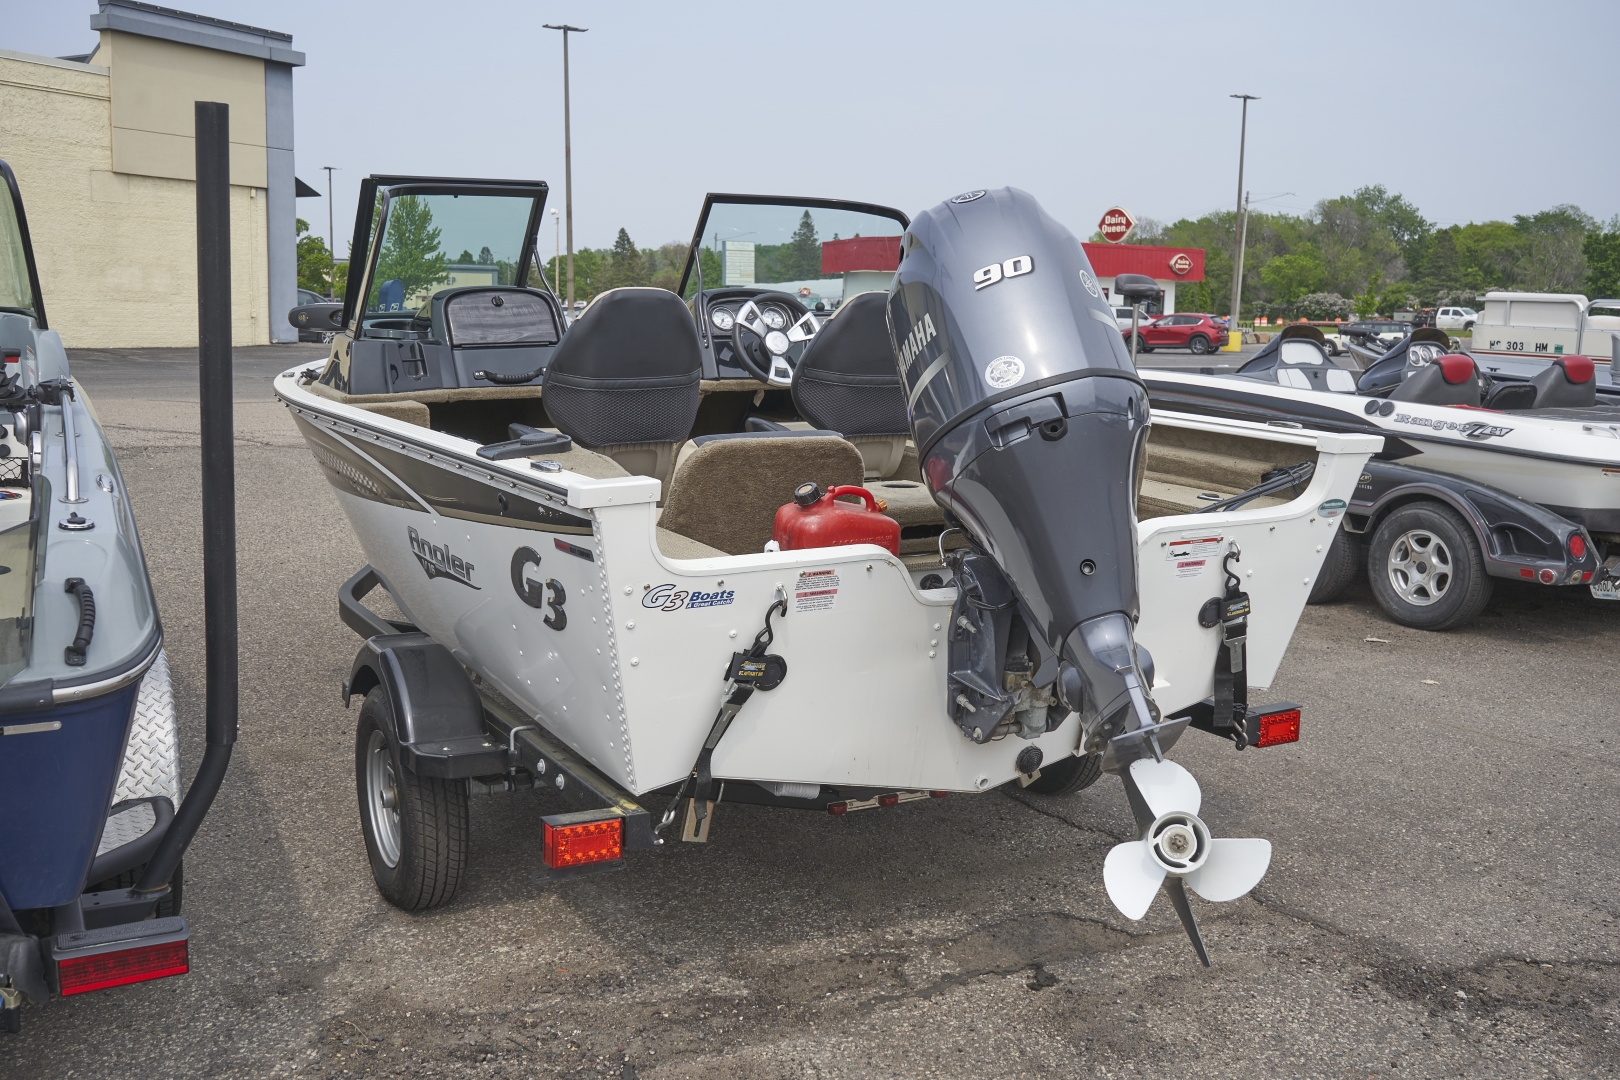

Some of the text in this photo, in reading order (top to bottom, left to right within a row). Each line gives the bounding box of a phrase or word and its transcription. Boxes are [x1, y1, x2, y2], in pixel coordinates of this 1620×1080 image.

[1104, 214, 1126, 225] Dairy
[973, 254, 1034, 291] 90
[1506, 341, 1525, 351] 303
[1534, 342, 1549, 353] HM
[1393, 412, 1469, 433] Ranger
[407, 525, 475, 582] Angler
[510, 545, 568, 632] G3
[641, 583, 735, 612] G3 Boats
